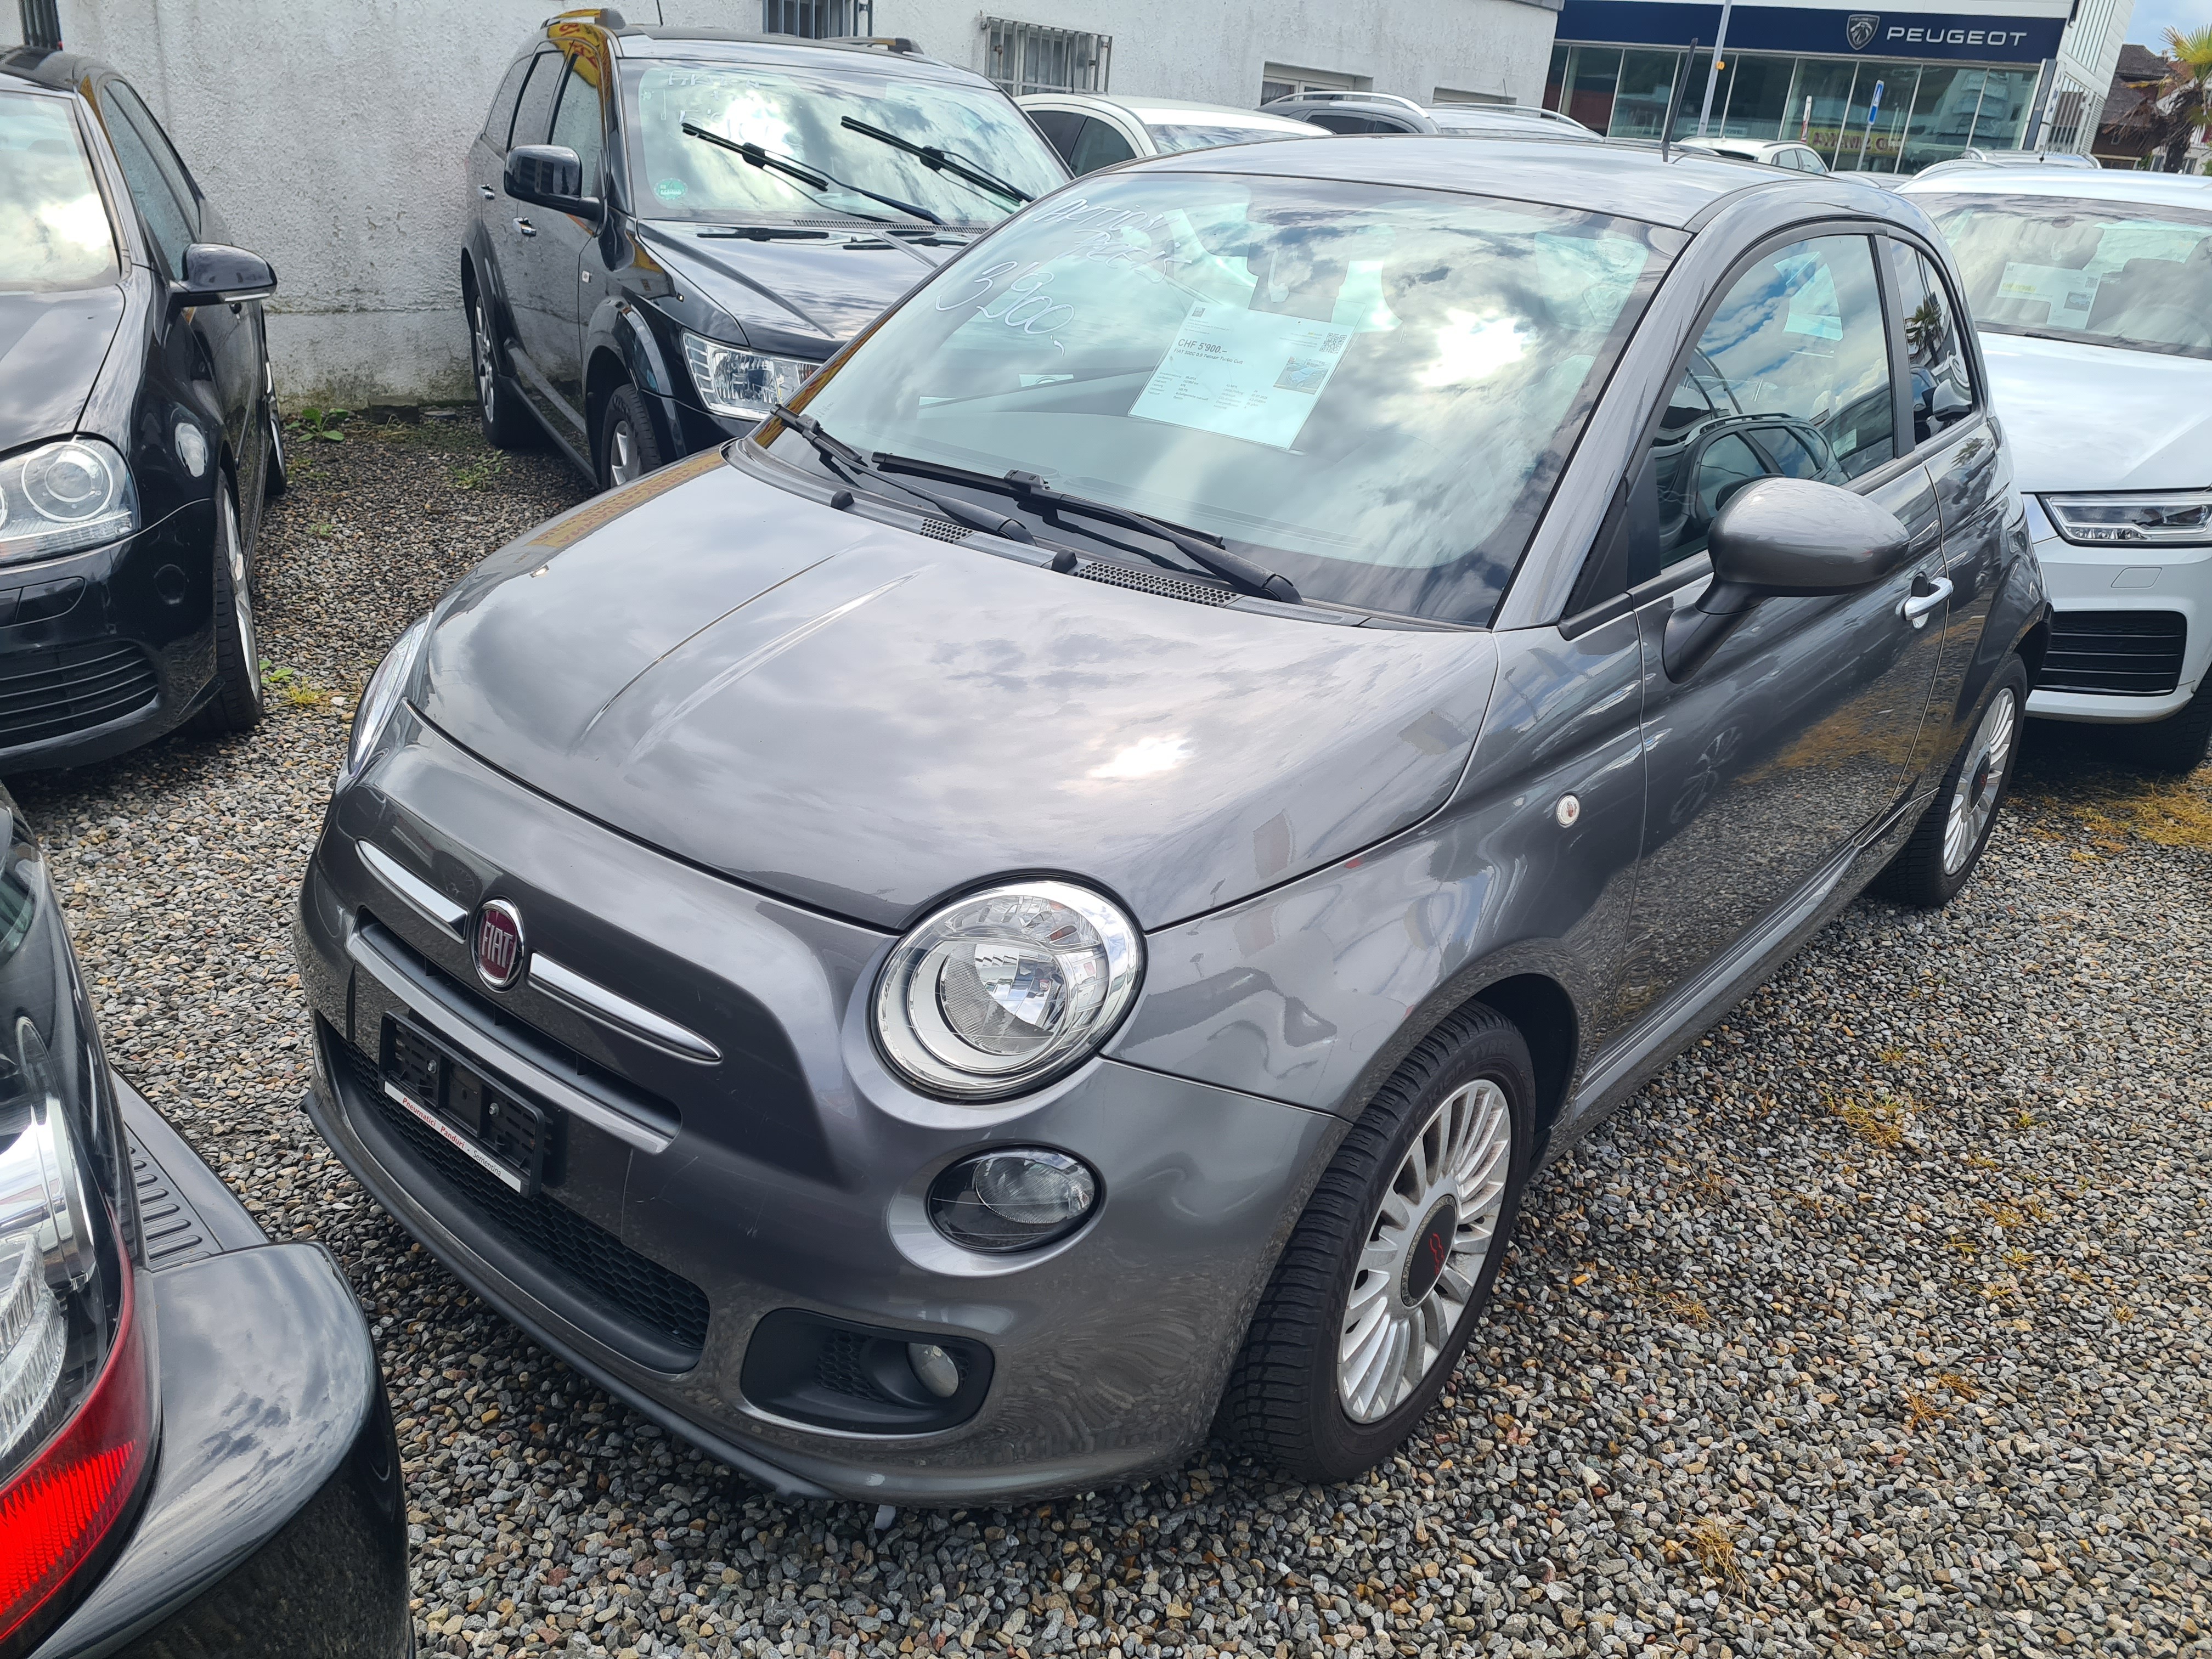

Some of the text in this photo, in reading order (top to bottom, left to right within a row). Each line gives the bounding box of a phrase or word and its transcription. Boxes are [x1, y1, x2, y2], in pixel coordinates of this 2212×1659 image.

[1886, 26, 2028, 47] PEUGEOT
[1177, 338, 1198, 349] CHF
[481, 921, 514, 969] FIAT
[402, 1096, 437, 1127] Pneumatici
[440, 1125, 466, 1149] Panduri
[472, 1150, 502, 1177] Sementina
